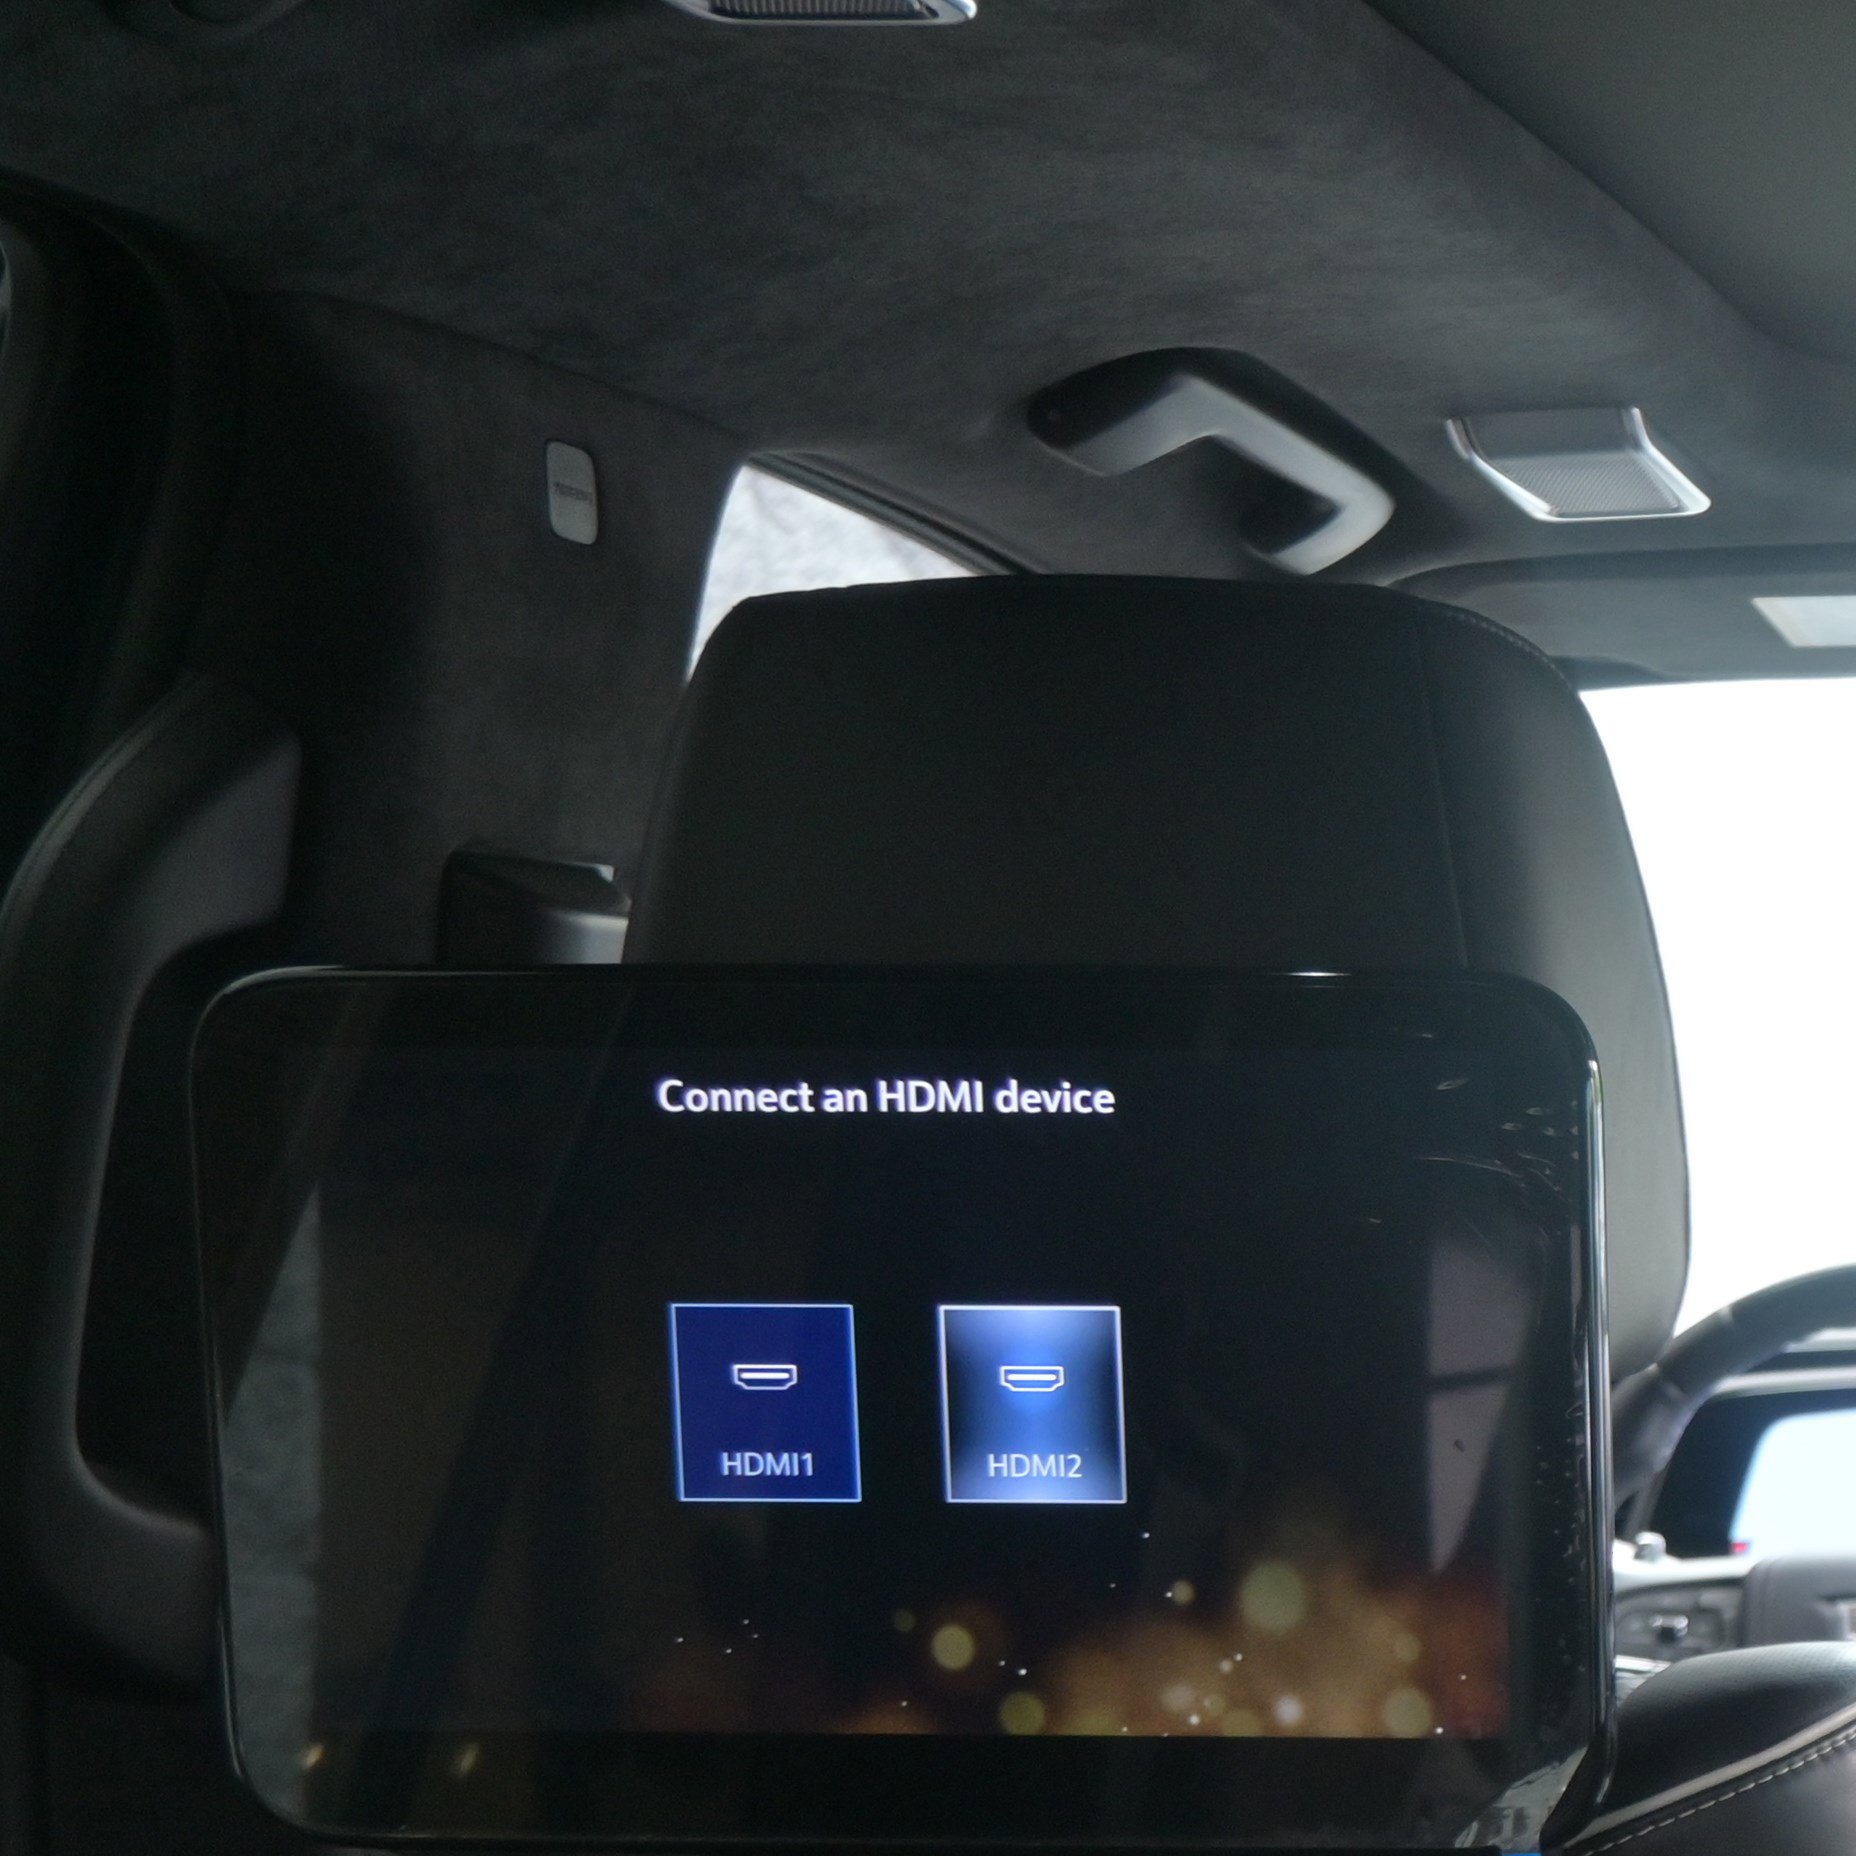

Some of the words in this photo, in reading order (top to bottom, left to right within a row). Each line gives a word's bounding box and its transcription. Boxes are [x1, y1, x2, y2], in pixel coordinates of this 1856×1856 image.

[657, 1078, 815, 1114] Connect
[822, 1087, 868, 1113] an
[878, 1080, 984, 1113] HDMI
[995, 1078, 1117, 1115] device
[721, 1452, 814, 1478] HDMI1
[988, 1453, 1083, 1479] HDMI2
